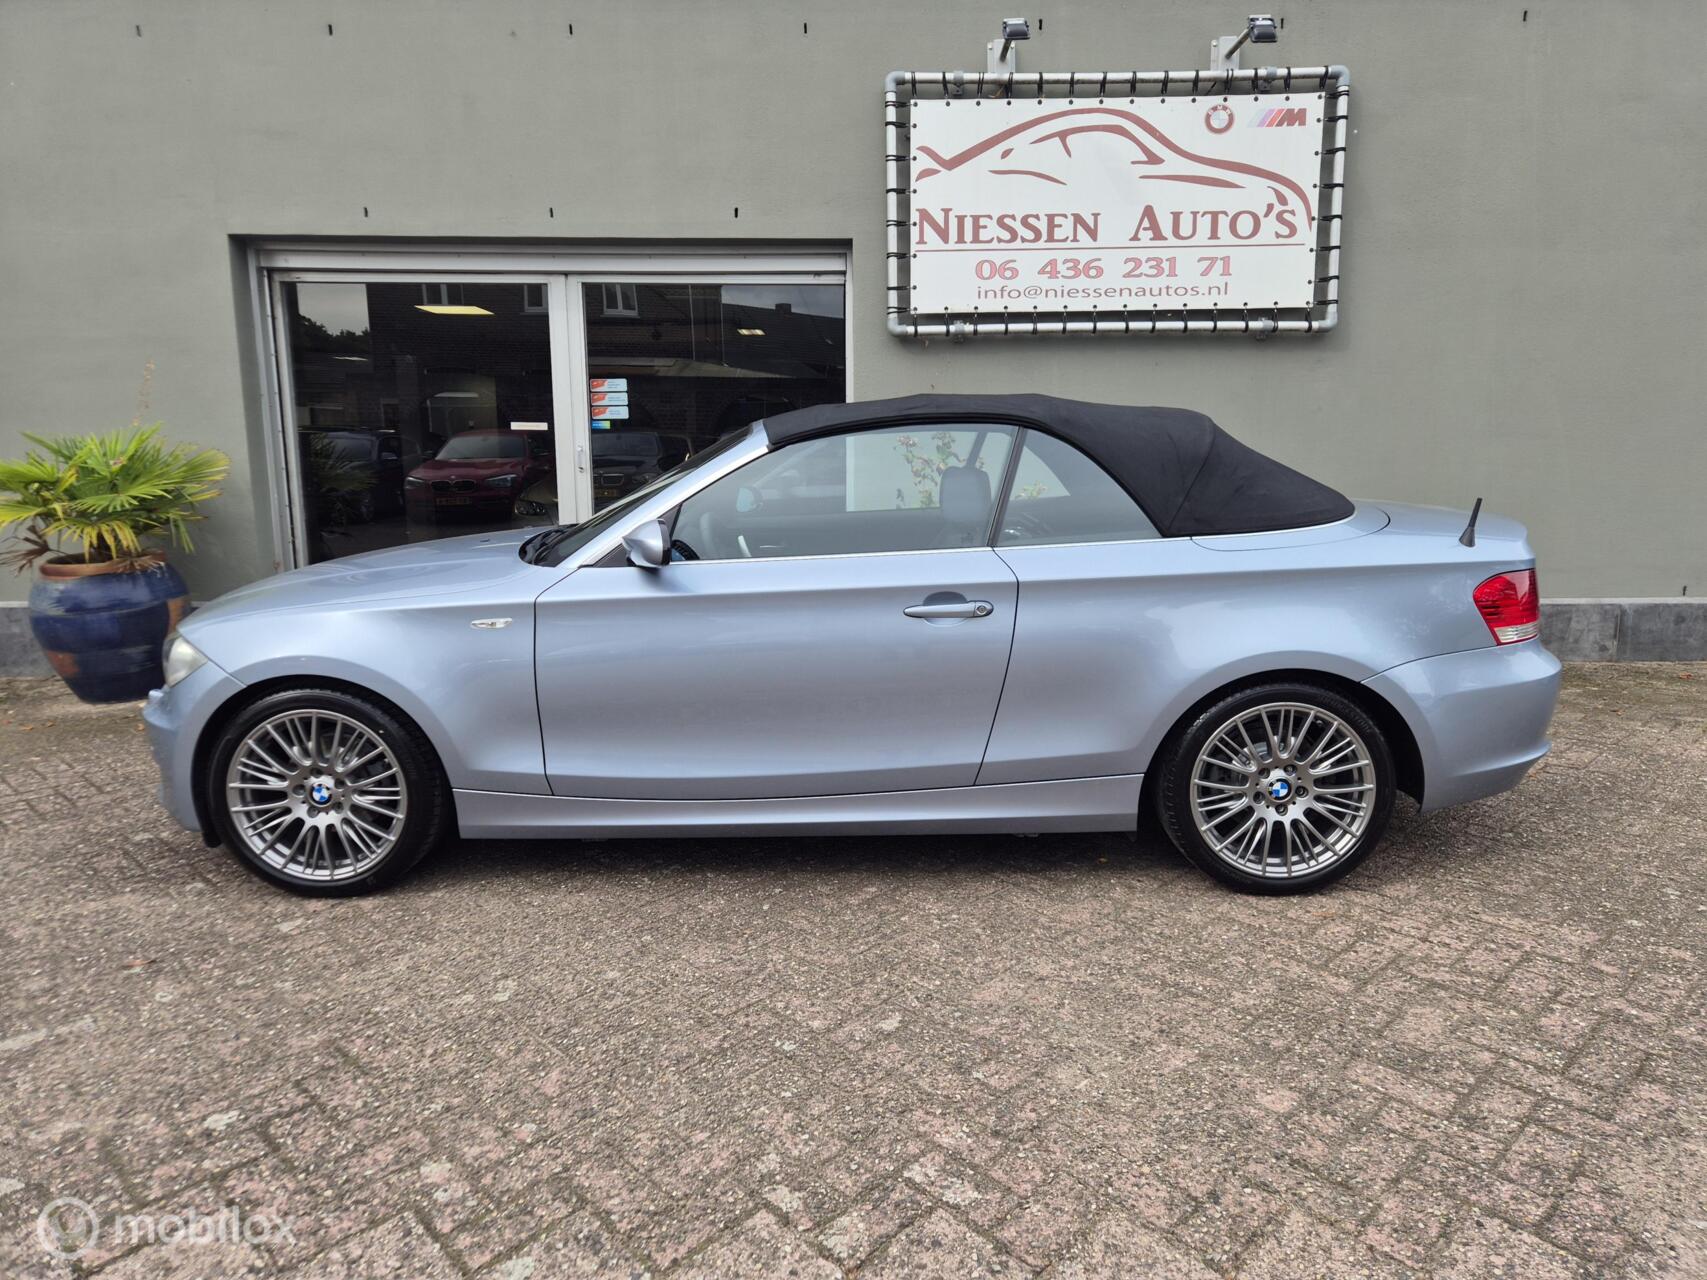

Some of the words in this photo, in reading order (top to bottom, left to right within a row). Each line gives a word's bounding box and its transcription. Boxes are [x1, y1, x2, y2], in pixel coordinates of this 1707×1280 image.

[915, 207, 1102, 245] NIESSEN
[1128, 202, 1298, 242] AUTO'S
[975, 258, 1020, 281] 06
[1037, 257, 1105, 280] 436
[1122, 256, 1178, 279] 231
[1197, 255, 1233, 277] 71
[977, 281, 1229, 300] info@niessenautos.nl
